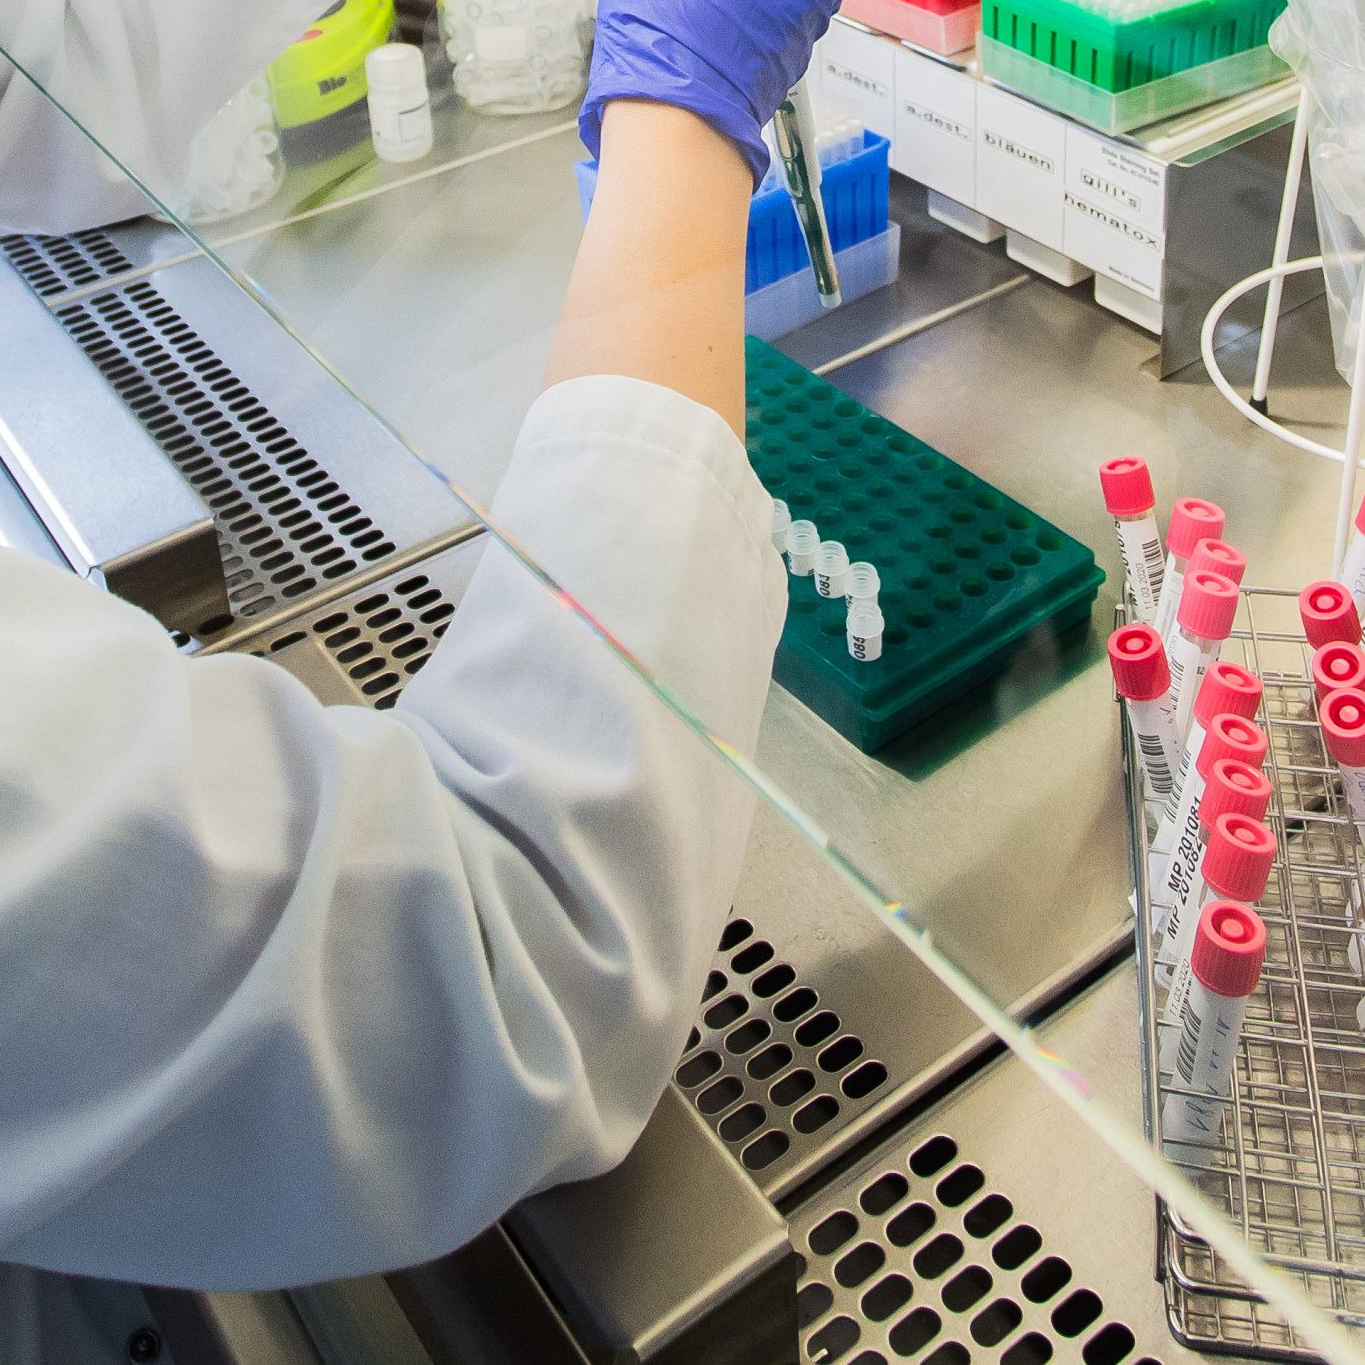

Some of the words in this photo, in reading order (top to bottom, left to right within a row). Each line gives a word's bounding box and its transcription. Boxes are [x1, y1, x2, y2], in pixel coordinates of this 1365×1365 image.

[906, 105, 969, 138] a.dest.
[1083, 173, 1138, 208] gill's
[1064, 192, 1158, 249] hematox
[853, 635, 866, 660] 085
[1168, 861, 1183, 892] MP
